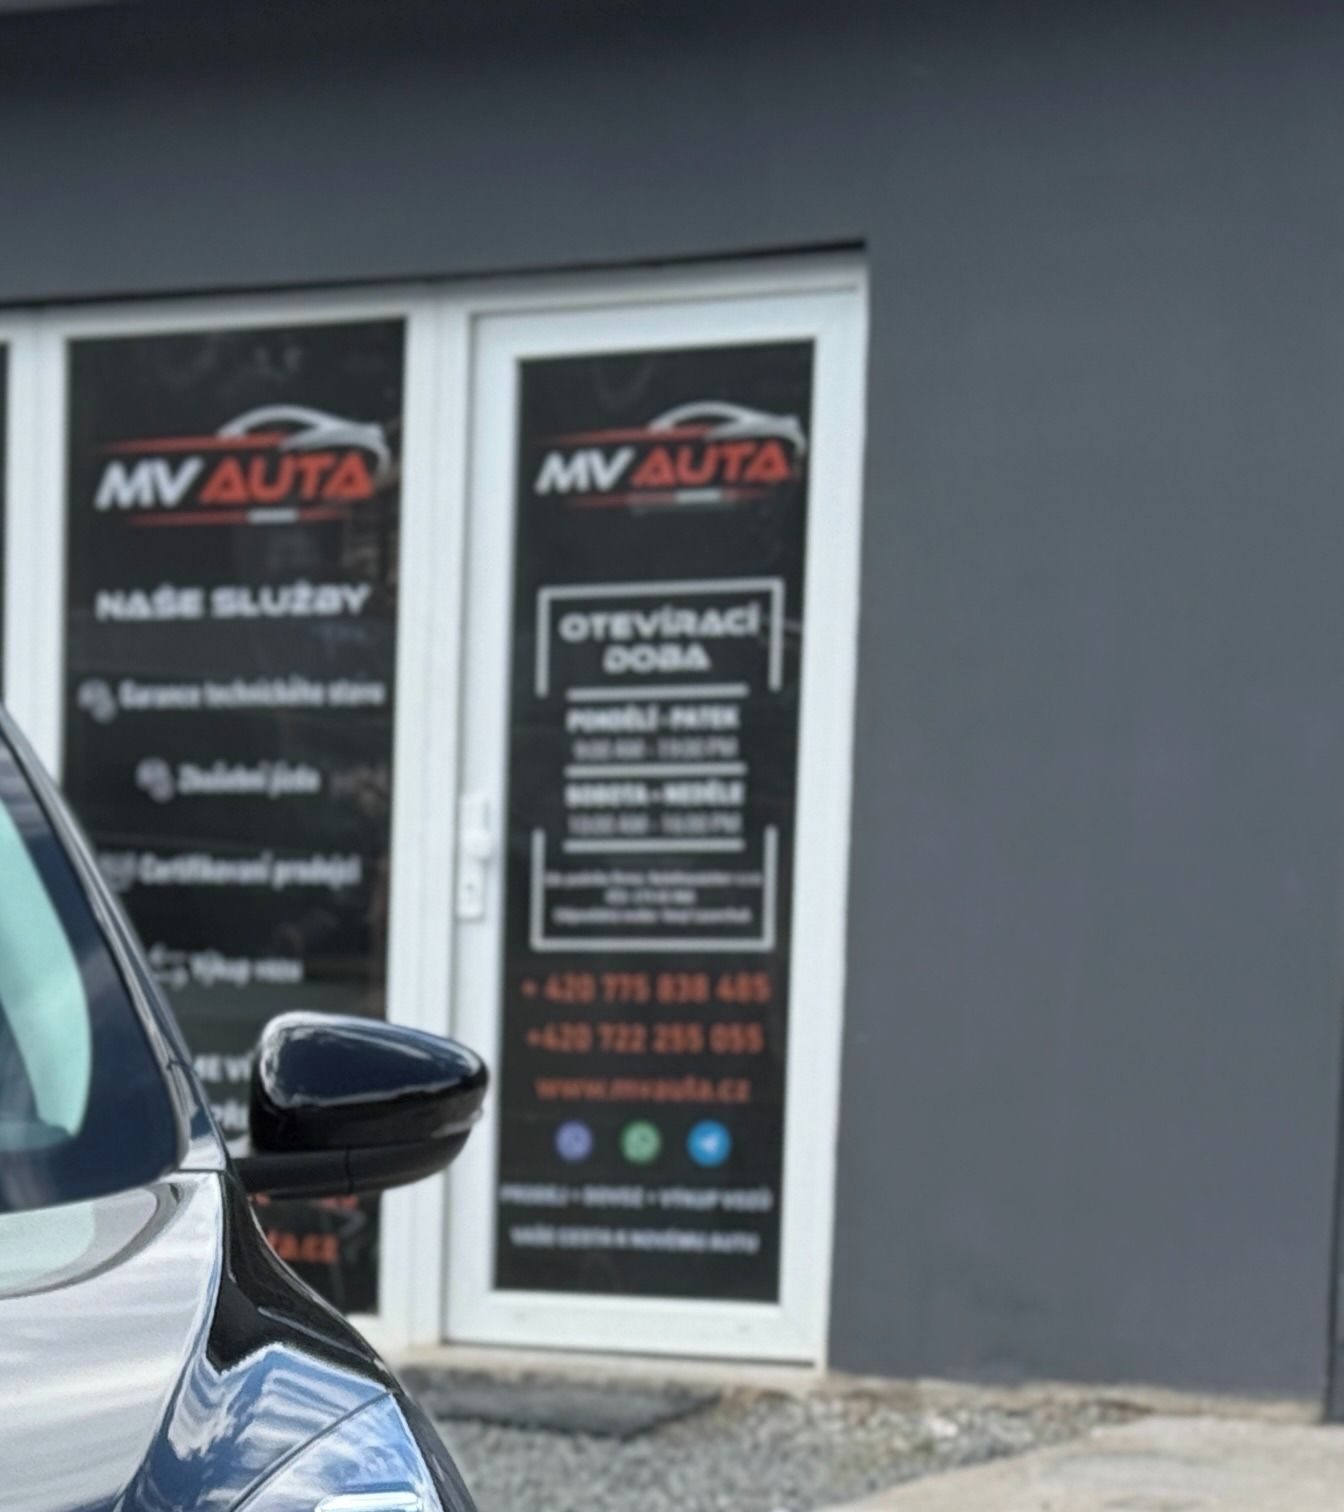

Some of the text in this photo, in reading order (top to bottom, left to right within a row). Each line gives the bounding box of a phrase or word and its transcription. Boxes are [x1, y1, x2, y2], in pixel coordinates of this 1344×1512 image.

[95, 452, 374, 509] MV AUTA
[535, 442, 792, 494] MV AUTA
[97, 579, 370, 619] NAŠE SLUŽBY
[558, 601, 761, 643] OTEVÍRACÍ
[603, 643, 712, 674] DOBA
[544, 972, 596, 1003] 420
